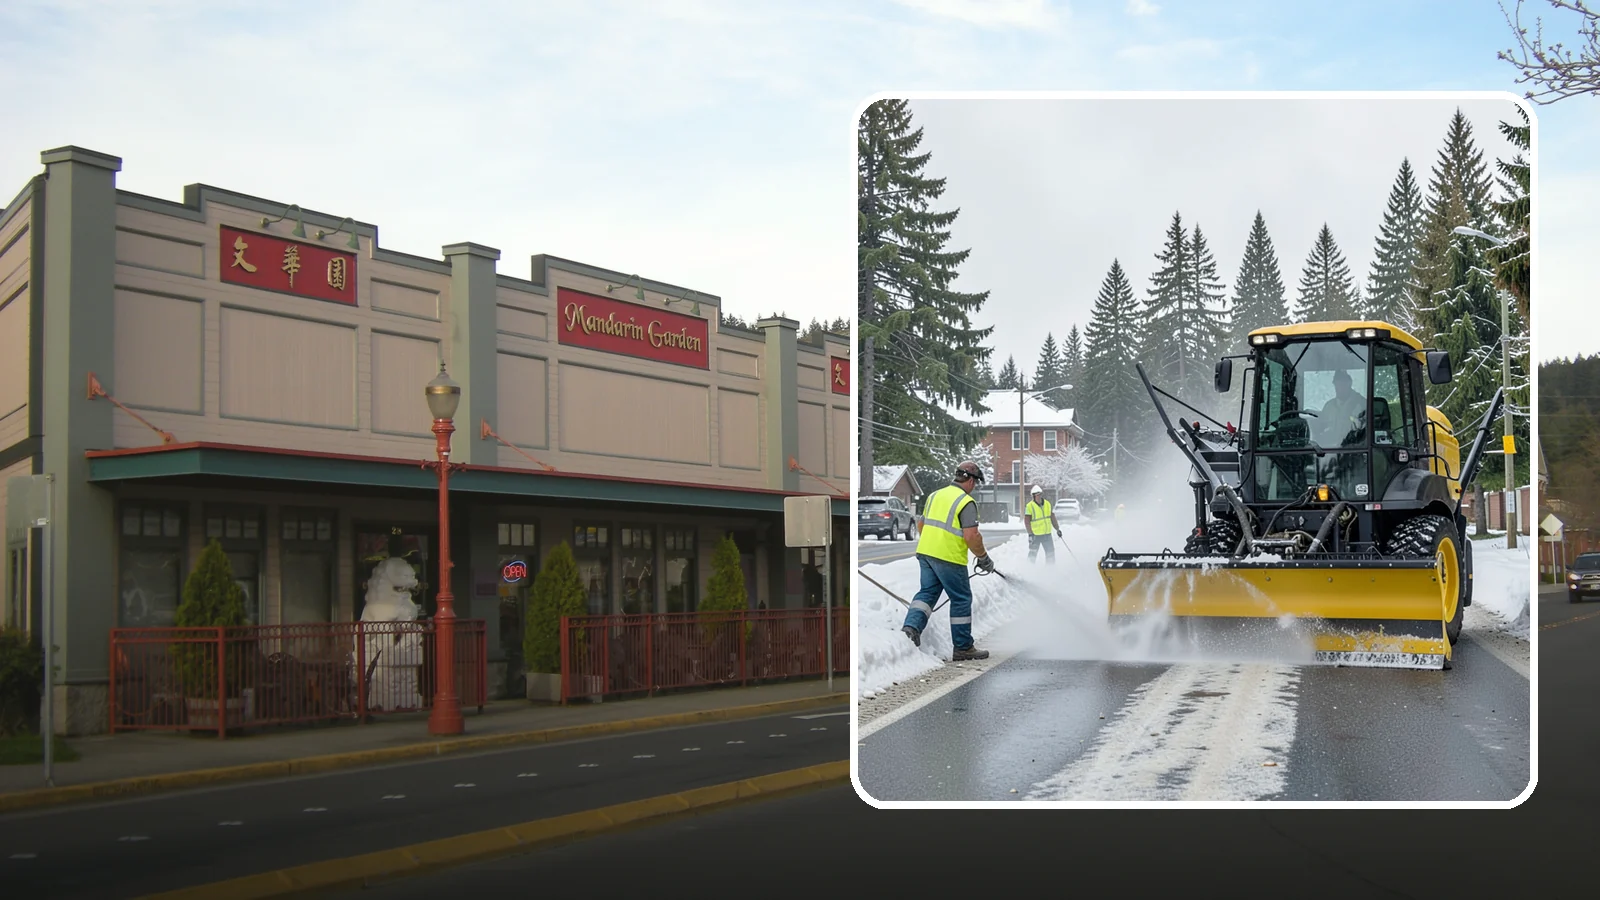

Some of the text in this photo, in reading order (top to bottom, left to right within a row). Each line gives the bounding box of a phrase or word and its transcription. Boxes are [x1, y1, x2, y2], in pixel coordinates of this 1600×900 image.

[231, 236, 346, 290] 文華園
[564, 302, 702, 352] Mandarin Garden
[503, 565, 527, 578] OPEN
